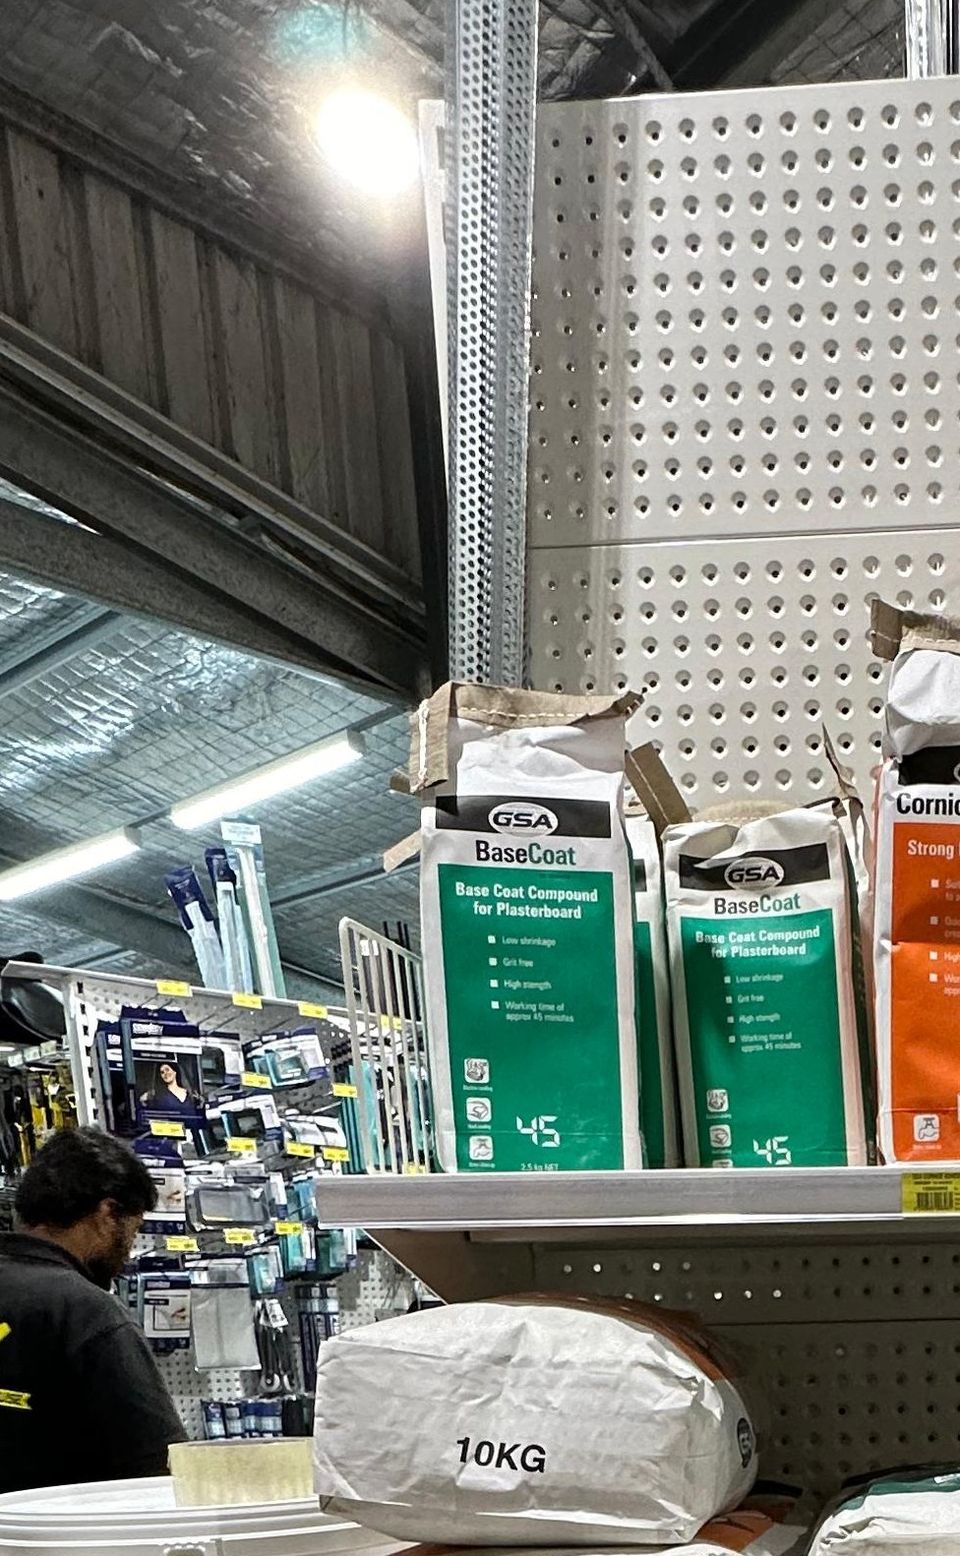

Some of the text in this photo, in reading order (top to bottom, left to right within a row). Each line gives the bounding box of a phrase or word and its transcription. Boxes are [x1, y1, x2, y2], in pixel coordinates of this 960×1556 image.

[492, 810, 554, 830] GSA
[476, 839, 576, 867] BaseCoat
[907, 839, 954, 860] Strong
[728, 865, 781, 883] GSA
[455, 881, 599, 903] Base Coat Compound
[473, 900, 582, 920] for Plasterboard
[714, 892, 801, 915] BaseCoat
[695, 925, 820, 944] Base Coat Compound
[711, 943, 806, 959] for Plasterboard
[505, 1001, 537, 1012] Working
[516, 1115, 560, 1147] 45
[753, 1136, 792, 1166] 45
[456, 1436, 548, 1474] 10KG
